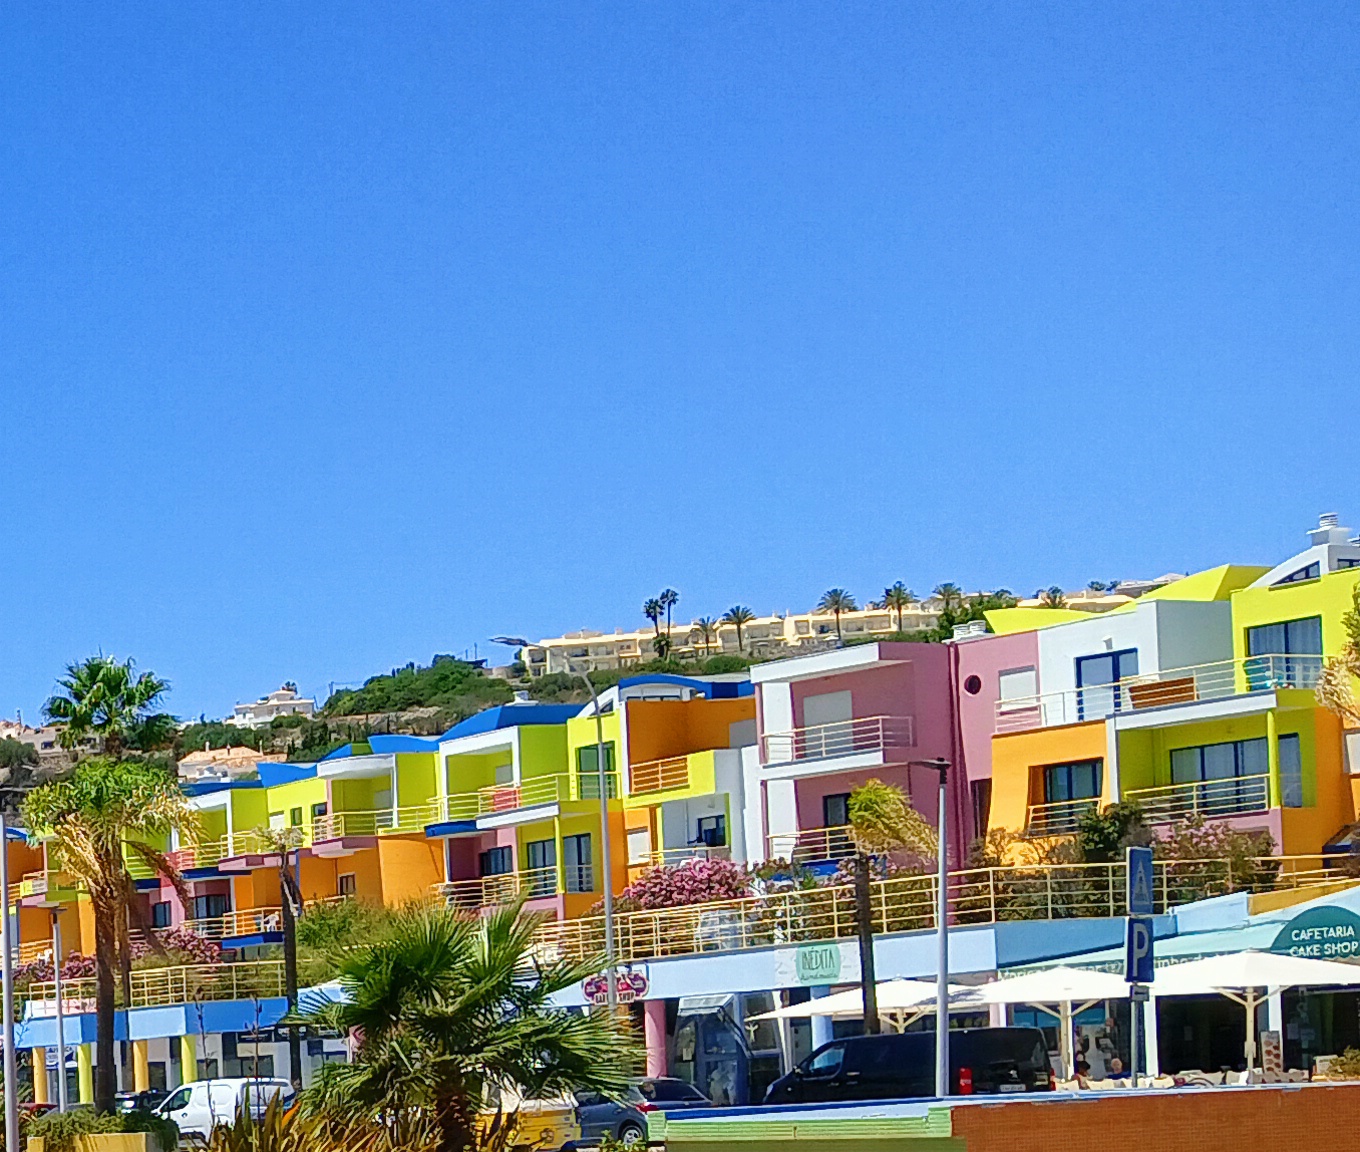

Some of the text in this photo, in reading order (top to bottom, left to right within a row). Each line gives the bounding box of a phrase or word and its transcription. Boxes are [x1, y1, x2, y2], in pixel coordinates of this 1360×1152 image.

[1291, 925, 1355, 941] CAFETARIA
[801, 947, 836, 970] INÉDITA
[1132, 922, 1149, 977] P
[1289, 941, 1359, 957] CAKE SHOP
